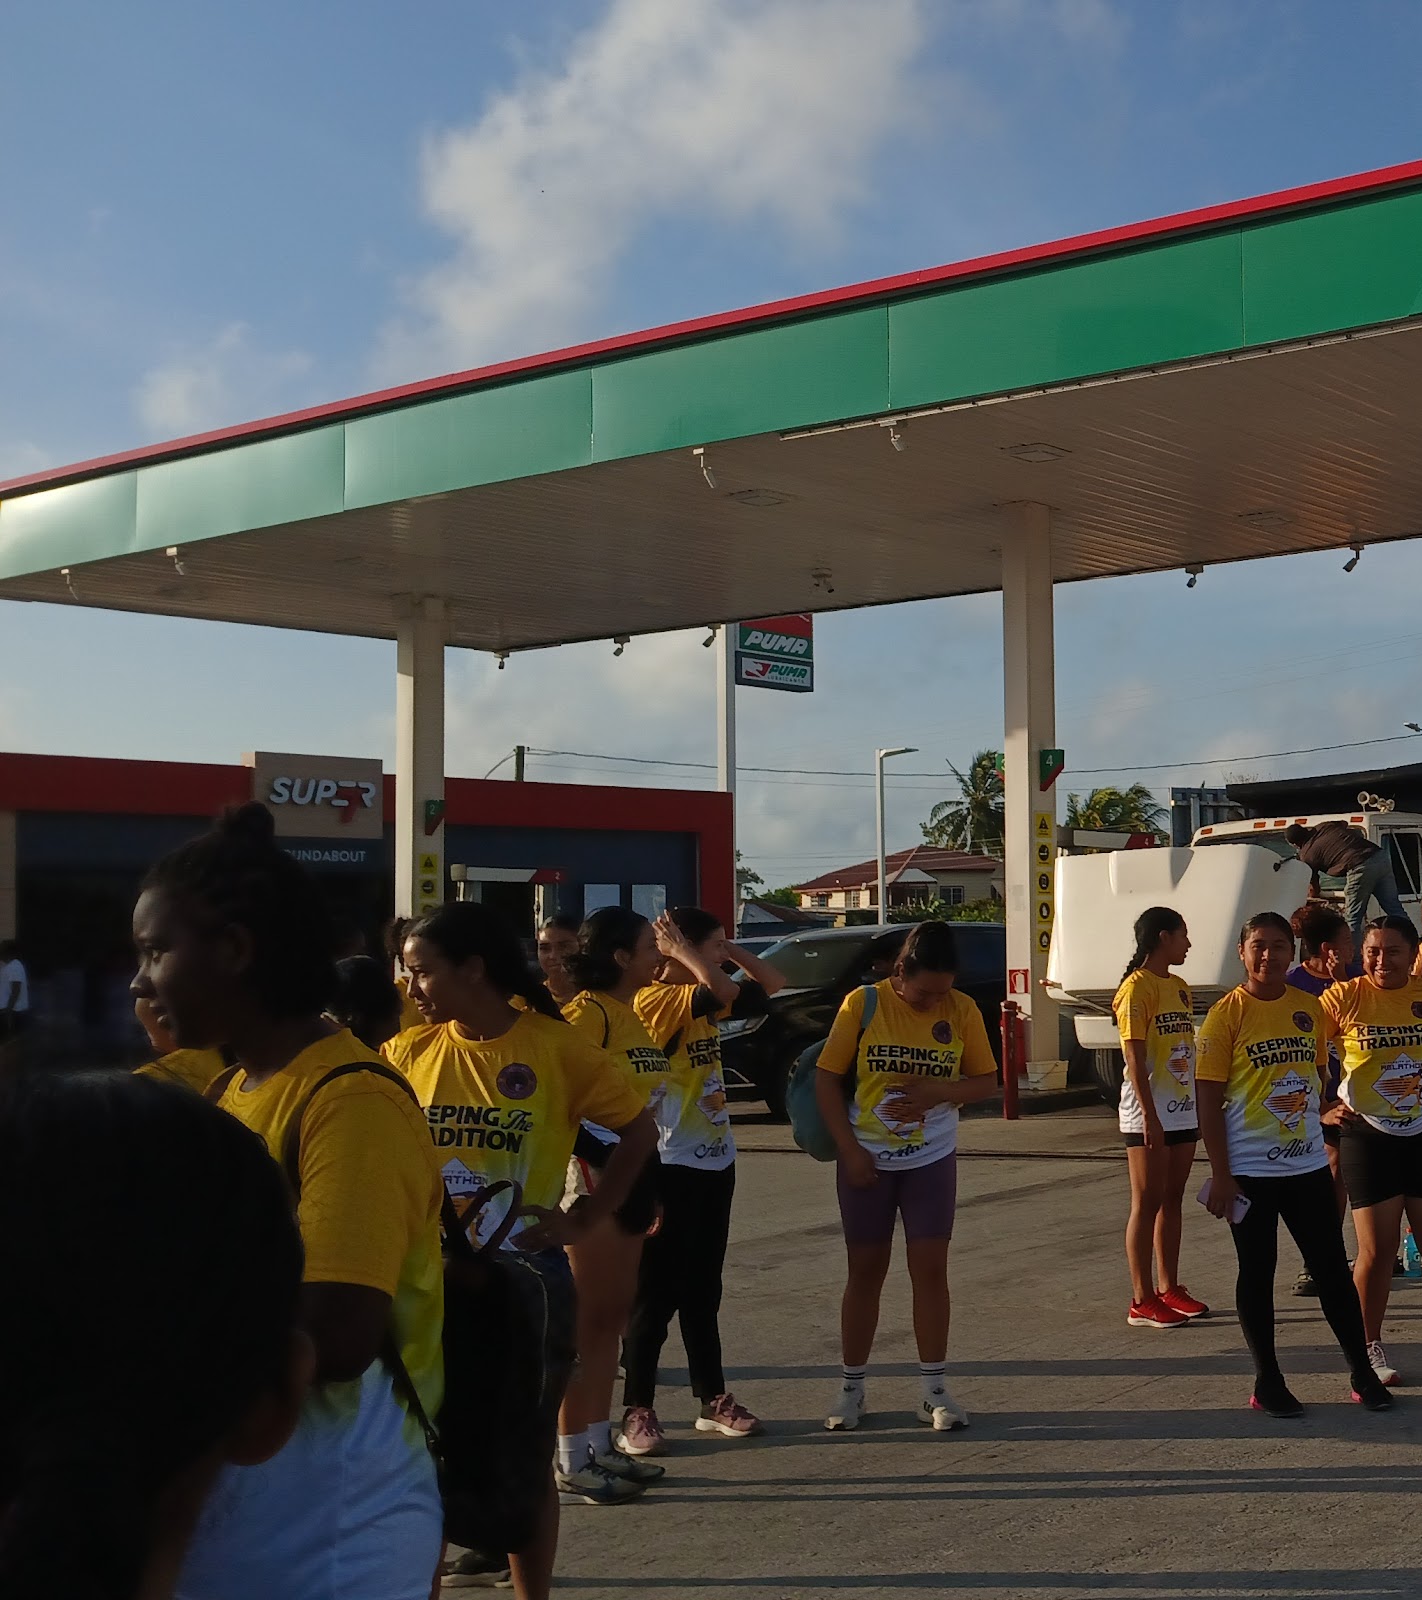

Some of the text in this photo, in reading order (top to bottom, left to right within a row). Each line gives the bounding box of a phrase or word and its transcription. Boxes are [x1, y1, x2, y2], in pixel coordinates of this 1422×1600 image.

[744, 630, 808, 654] PUMA
[769, 664, 808, 678] PUMA
[1046, 754, 1054, 767] 4
[430, 804, 436, 815] 2
[284, 849, 366, 862] UNDABOUT
[1156, 1023, 1195, 1036] TRADITI
[866, 1044, 959, 1064] KEEPING The
[1245, 1037, 1307, 1057] KEEPING
[866, 1059, 954, 1078] TRADITION
[428, 1105, 534, 1132] EPING The
[429, 1126, 523, 1153] DITION
[1267, 1138, 1313, 1160] Alive
[444, 1175, 488, 1185] ATHON
